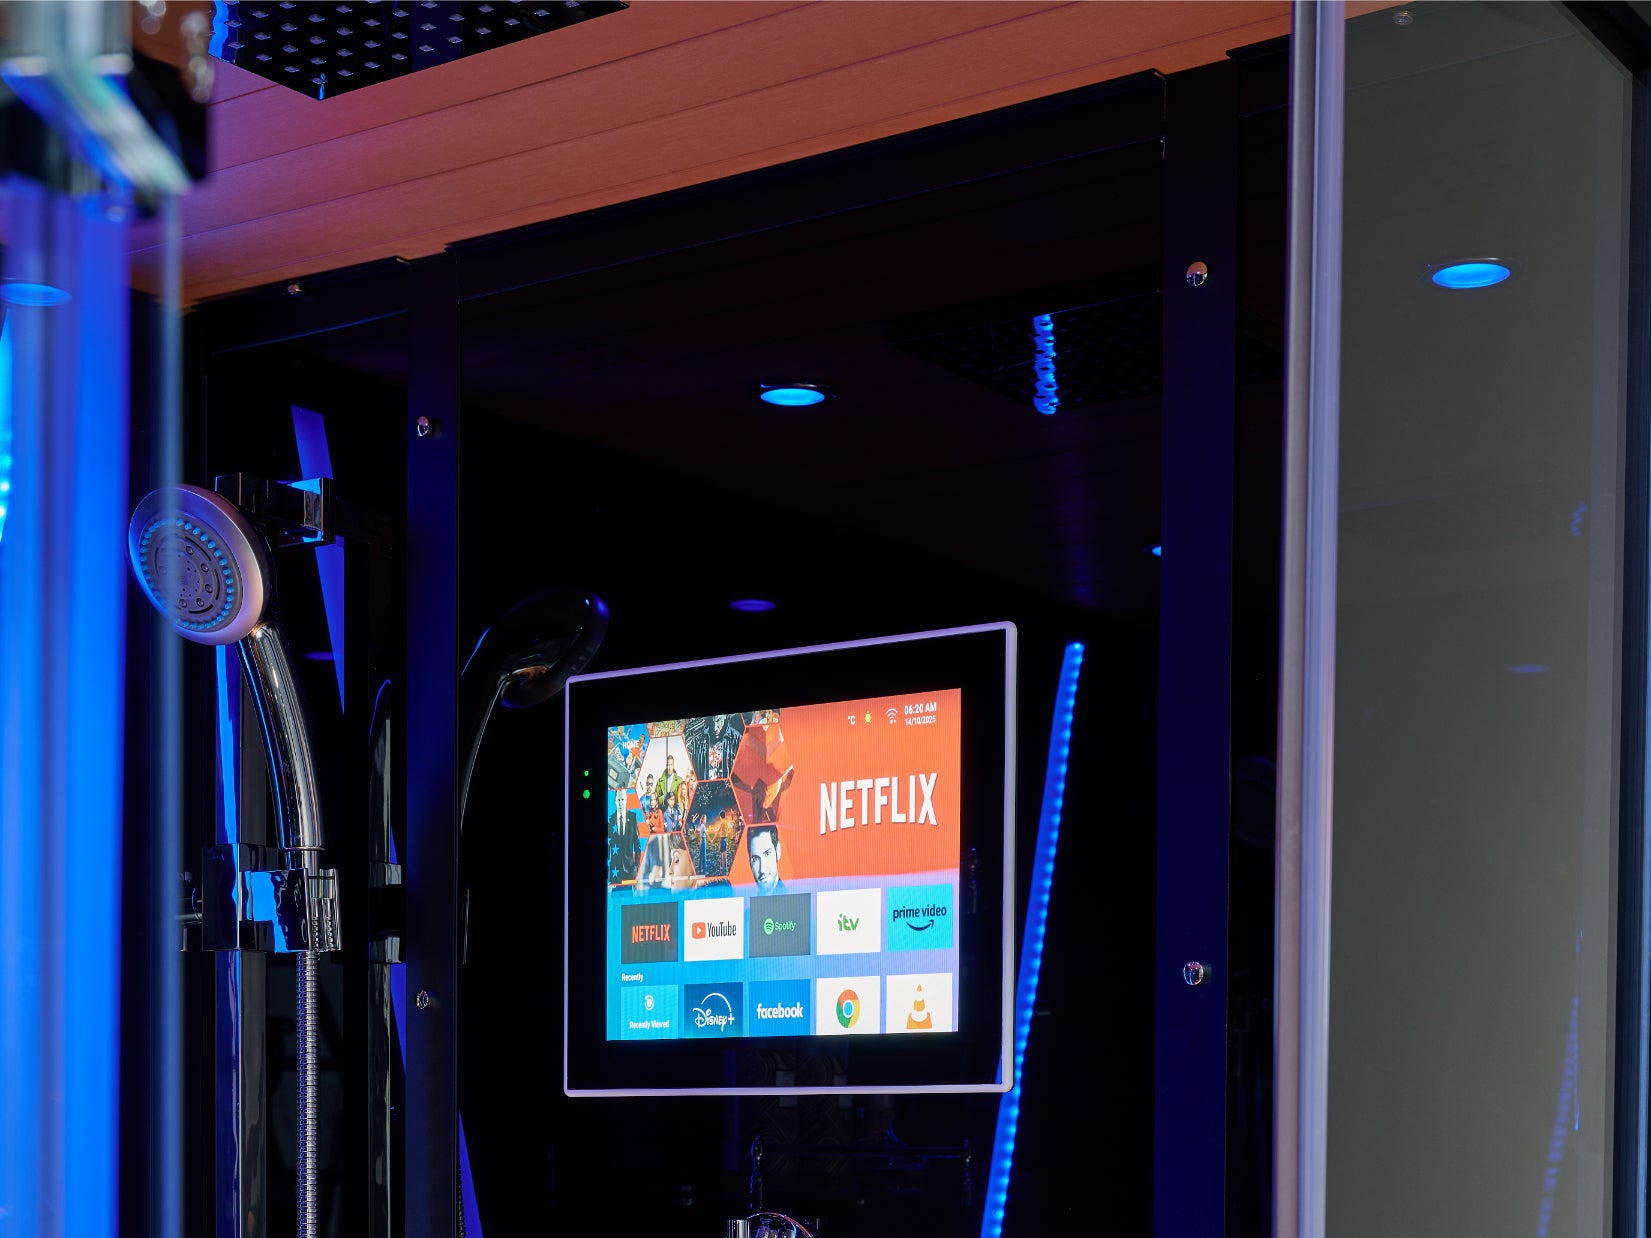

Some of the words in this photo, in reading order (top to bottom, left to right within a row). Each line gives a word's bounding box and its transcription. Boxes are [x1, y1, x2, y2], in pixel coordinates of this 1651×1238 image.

[904, 703, 924, 714] 06:20
[925, 702, 936, 712] AM
[819, 773, 938, 835] NETFLIX
[893, 907, 919, 922] prime
[921, 904, 947, 918] video
[707, 921, 737, 938] YouTube
[775, 921, 795, 934] Spotify
[837, 913, 859, 931] itv
[631, 924, 671, 944] NETFLIX
[621, 972, 644, 983] Recently
[756, 1002, 803, 1019] facebook
[629, 1020, 650, 1030] Recently
[651, 1019, 670, 1029] Viewed
